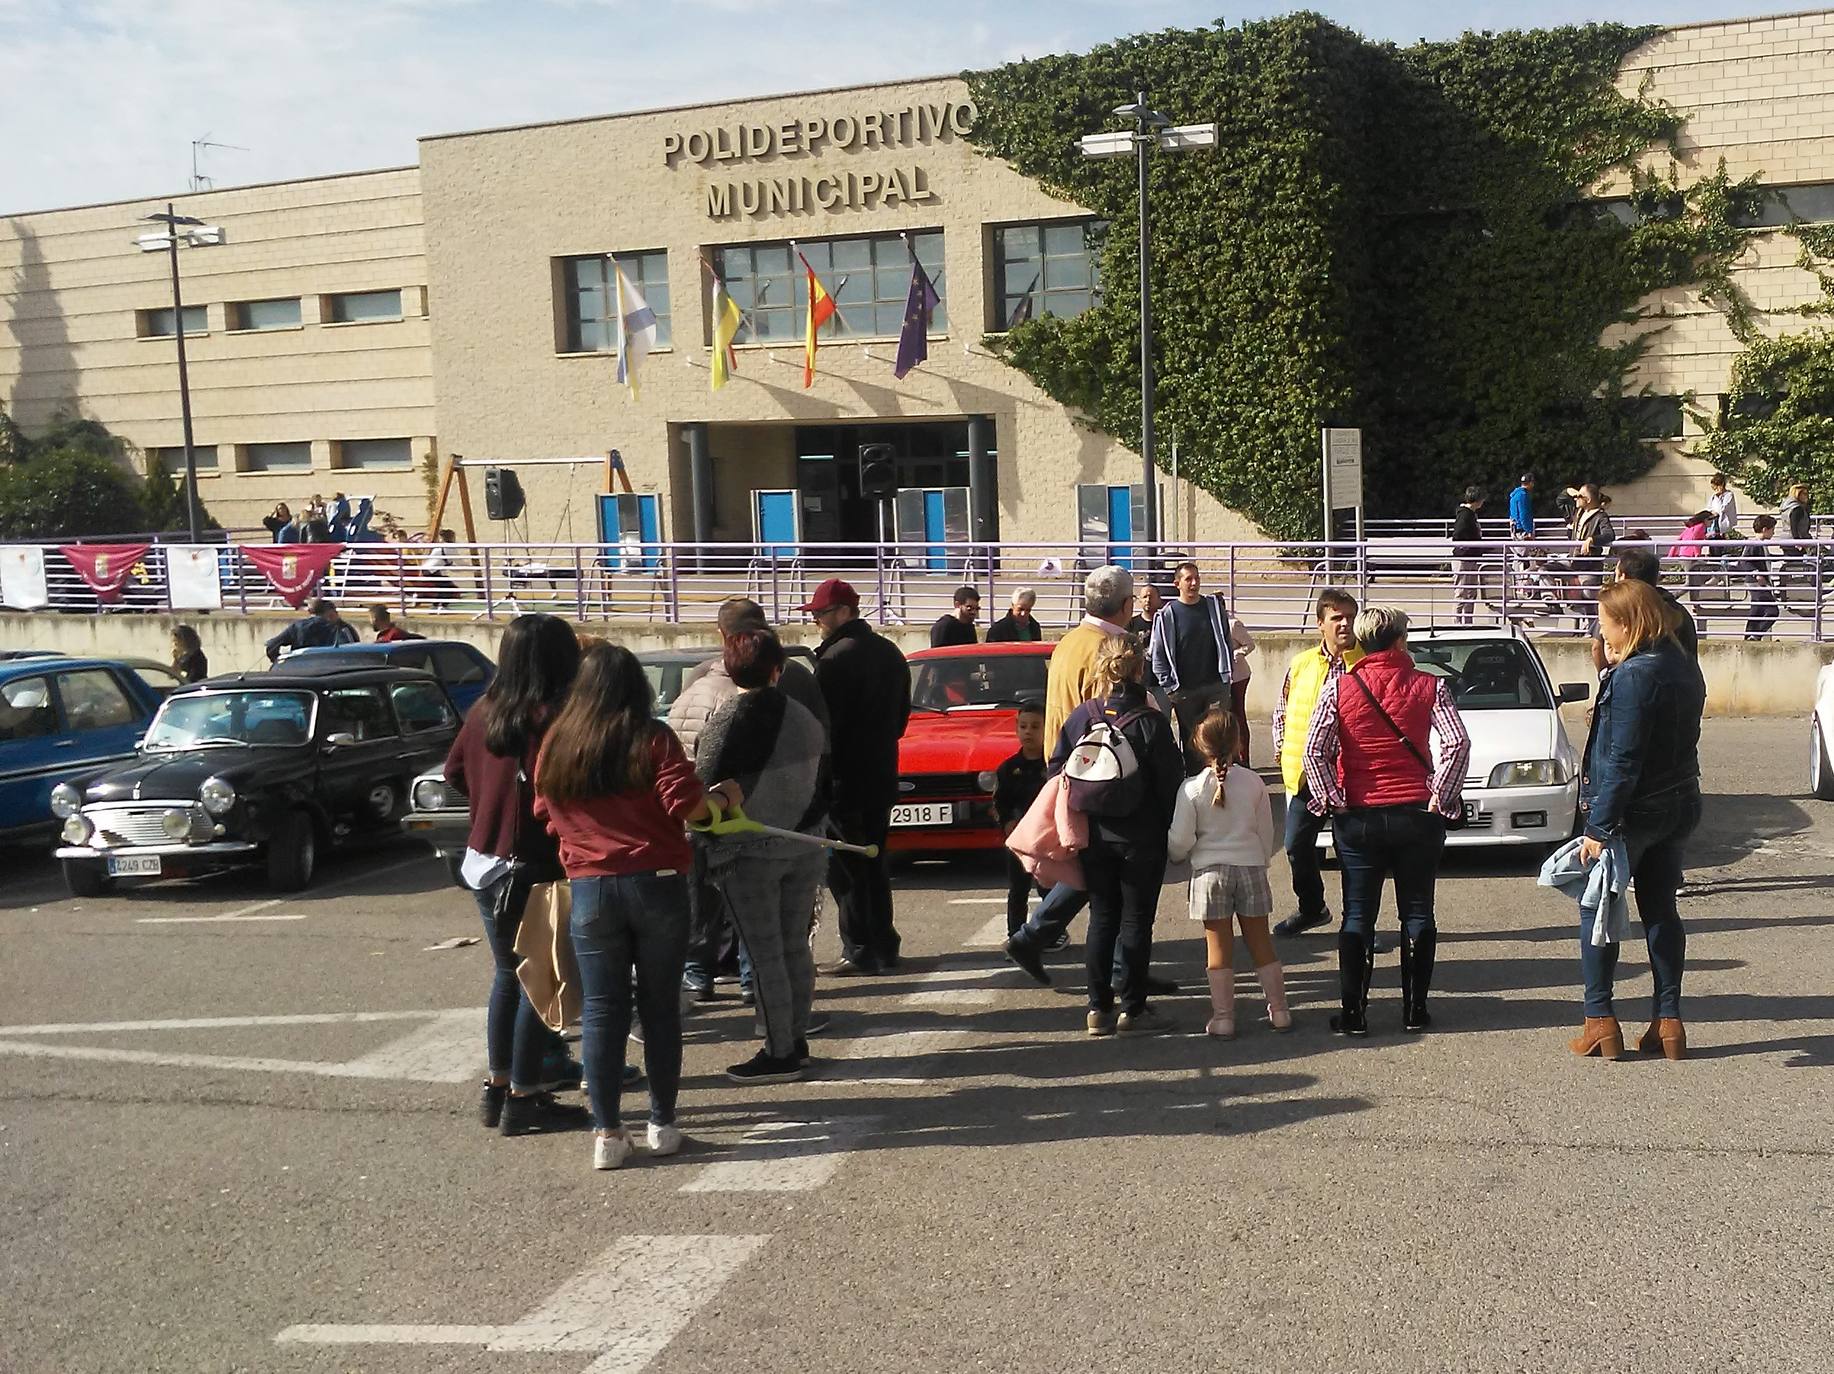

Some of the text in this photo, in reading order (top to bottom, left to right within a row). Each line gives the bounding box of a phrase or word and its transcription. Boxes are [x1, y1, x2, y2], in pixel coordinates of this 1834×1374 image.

[663, 101, 978, 164] POLIDEPORTIVO
[707, 165, 930, 217] MUNICIPAL
[892, 806, 949, 823] 2918 F
